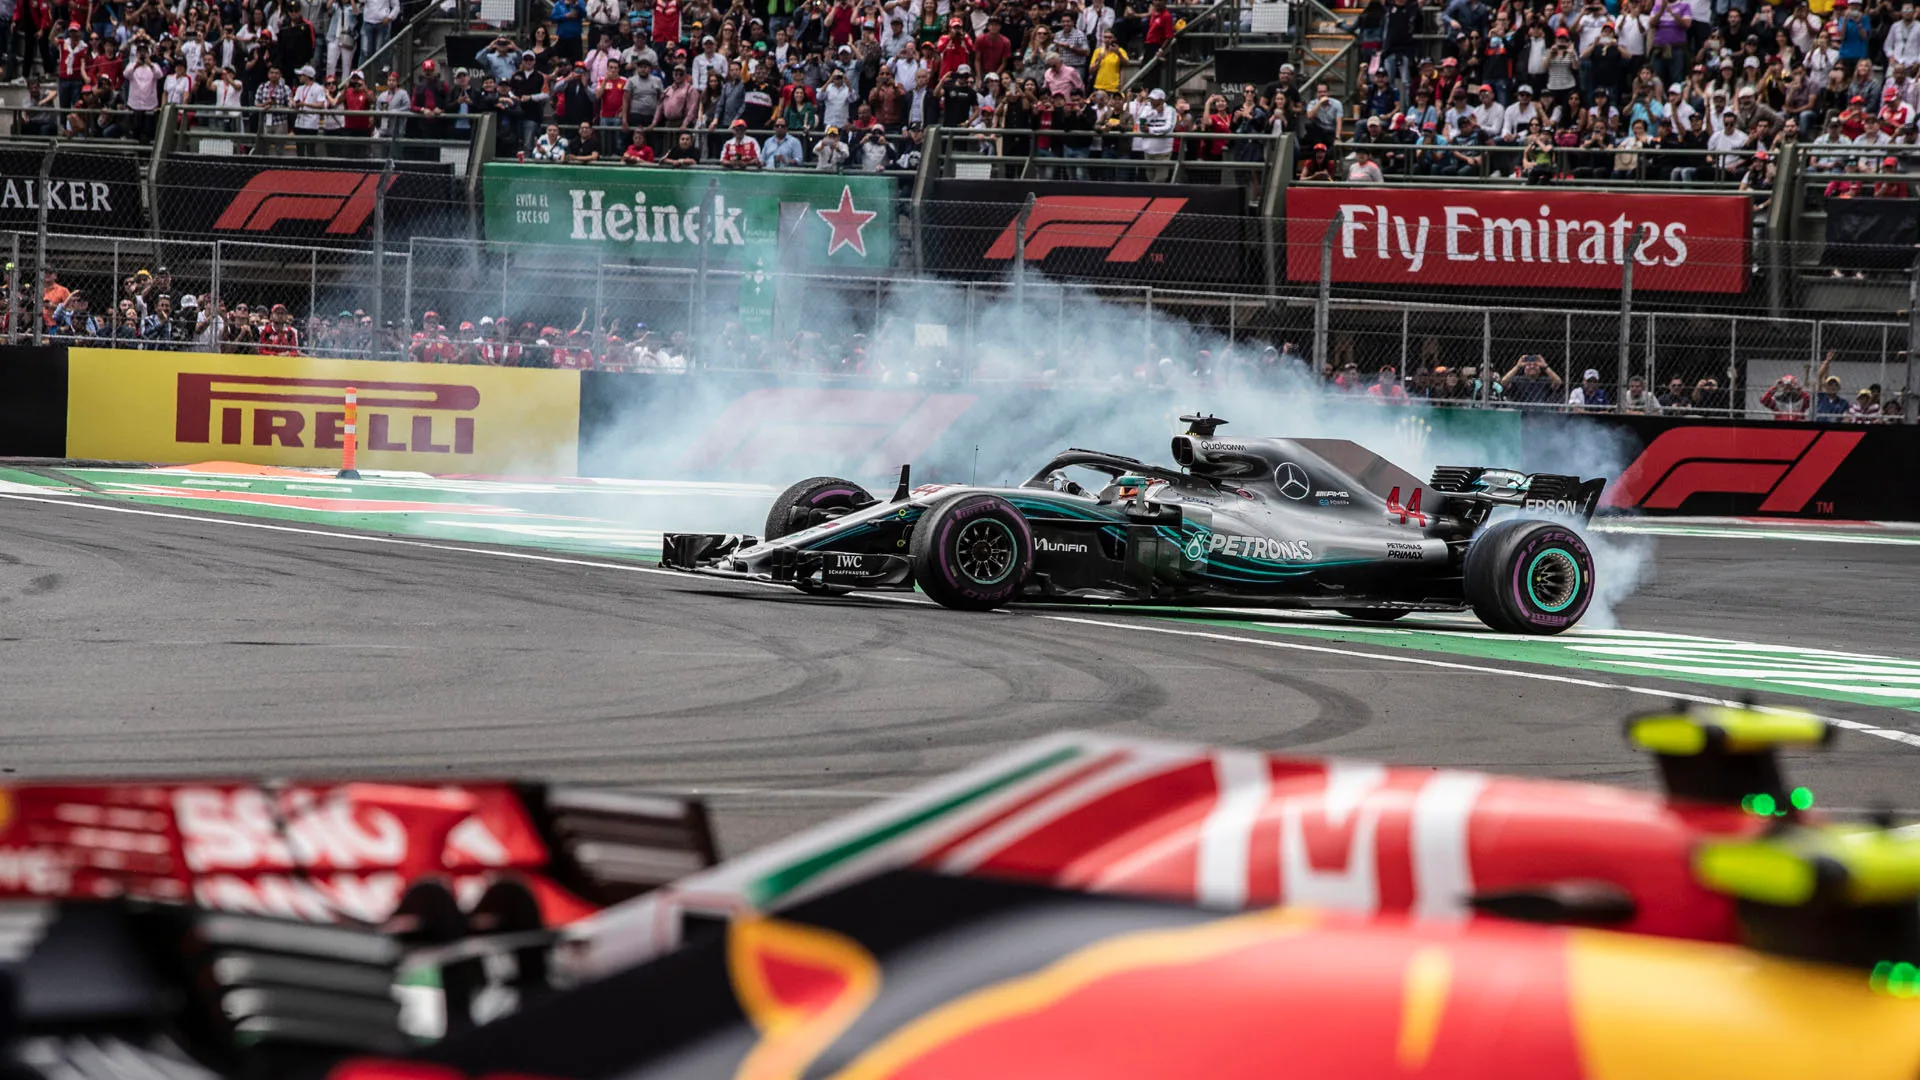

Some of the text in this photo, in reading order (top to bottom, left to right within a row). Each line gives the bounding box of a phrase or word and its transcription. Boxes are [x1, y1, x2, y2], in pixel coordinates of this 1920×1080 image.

[516, 194, 549, 207] EVITA EL
[516, 210, 550, 224] EXCESO
[569, 189, 748, 245] Heinek
[1339, 204, 1688, 272] Fly Emirates
[176, 373, 480, 454] PIRELLI
[1201, 441, 1247, 451] Qualcomm
[1386, 487, 1427, 527] 44
[1525, 499, 1577, 515] EPSON
[1816, 502, 1834, 514] TM
[1208, 533, 1314, 561] PETRONAS
[1386, 542, 1423, 550] PETRONAS
[1543, 532, 1586, 553] ZERO
[836, 555, 863, 568] IWC
[1387, 550, 1424, 560] PRIMAX
